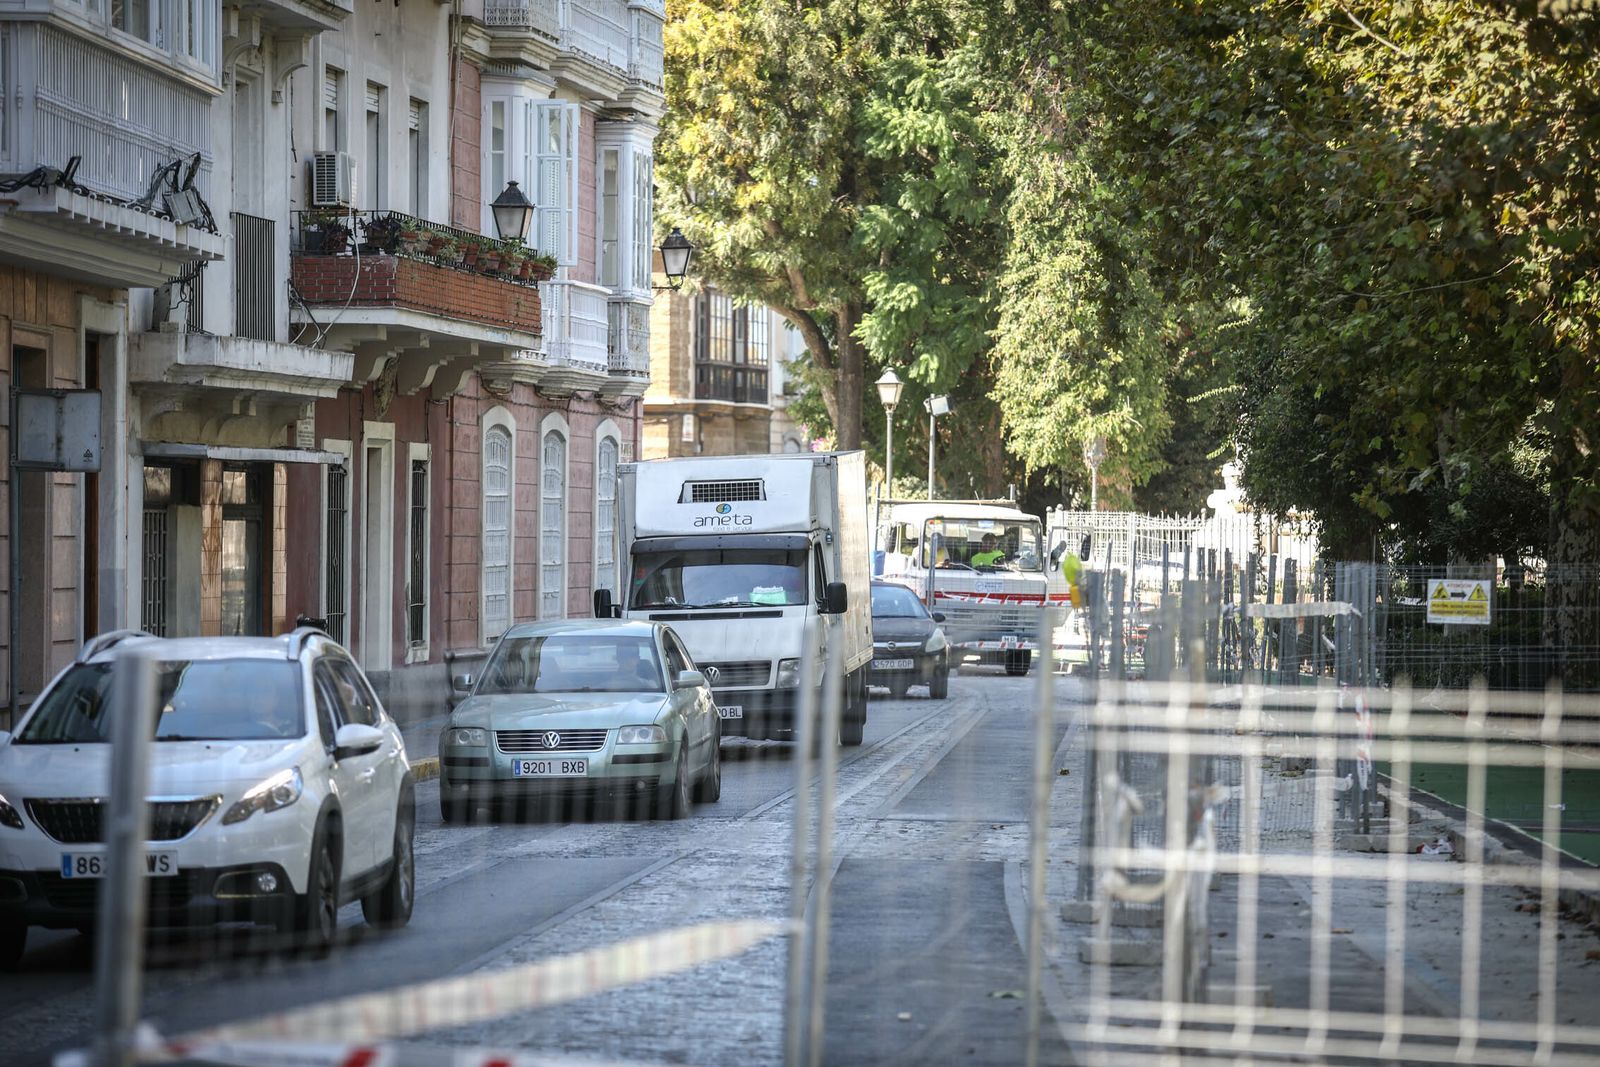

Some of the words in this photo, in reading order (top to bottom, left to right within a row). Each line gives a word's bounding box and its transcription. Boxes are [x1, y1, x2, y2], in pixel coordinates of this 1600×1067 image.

[693, 513, 753, 527] ameta
[730, 707, 742, 718] BL
[522, 761, 552, 774] 9201
[561, 761, 585, 774] BXB
[76, 856, 108, 876] 86
[145, 854, 171, 873] WS
